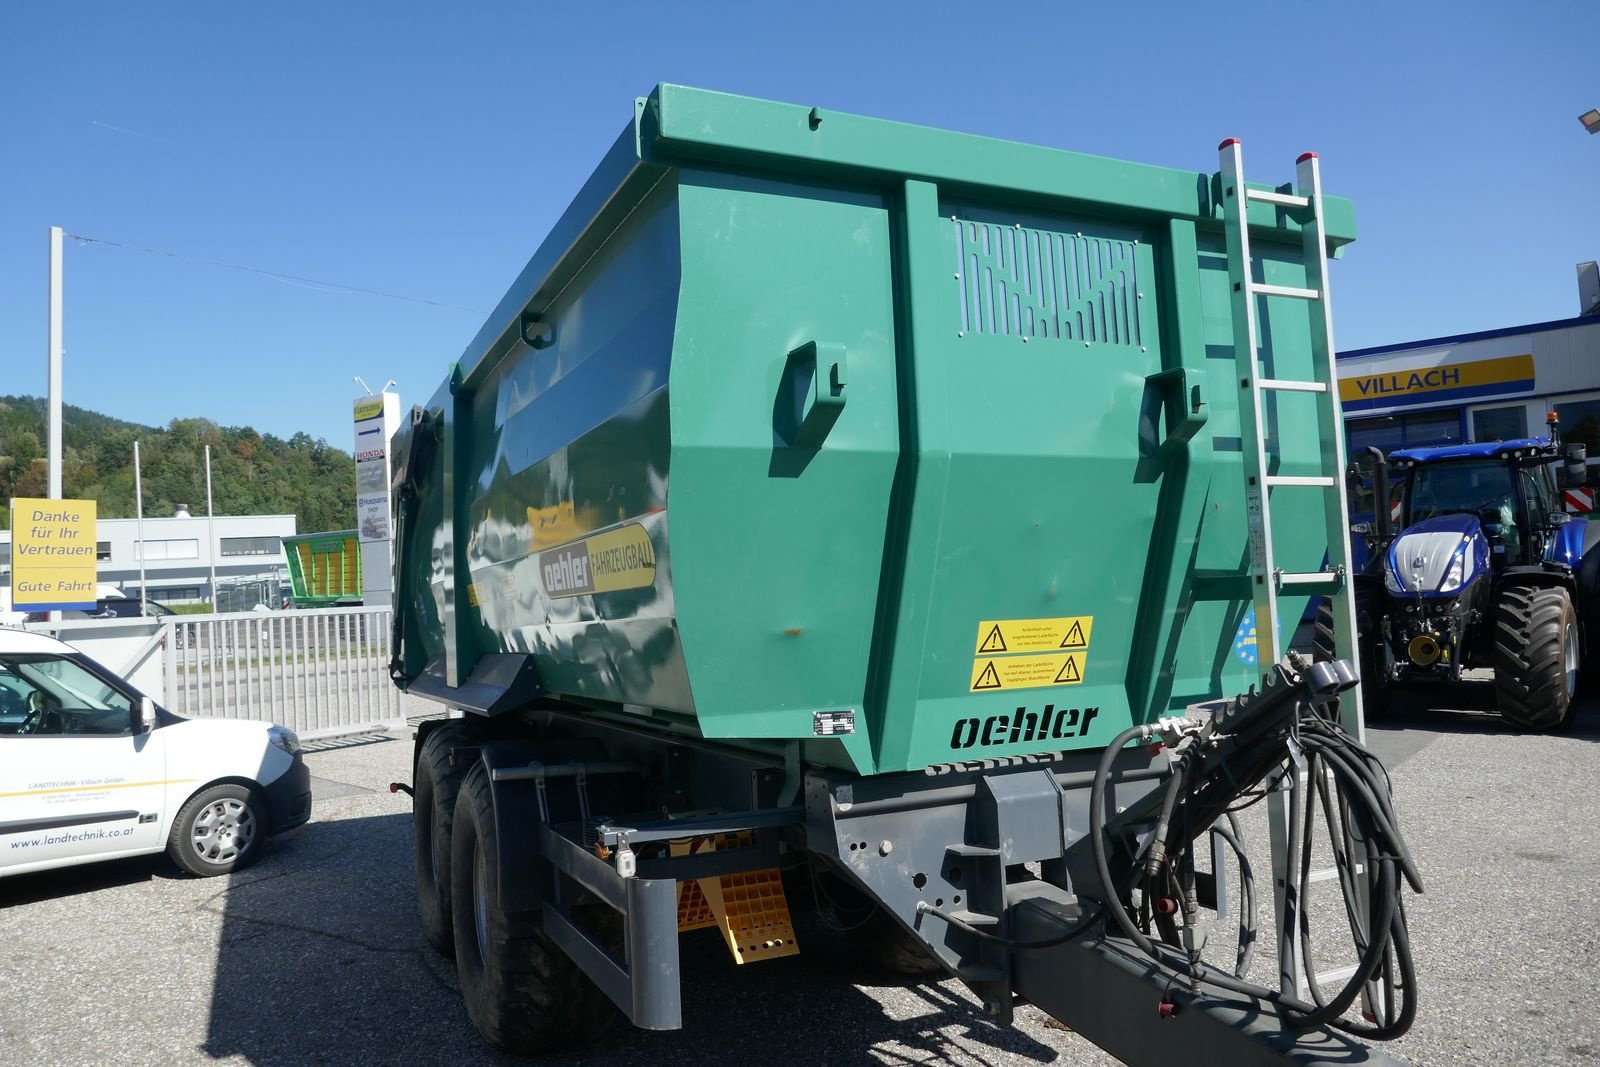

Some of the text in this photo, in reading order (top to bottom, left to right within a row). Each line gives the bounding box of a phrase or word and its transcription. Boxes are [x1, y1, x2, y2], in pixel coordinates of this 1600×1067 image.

[1356, 368, 1460, 395] VILLACH
[357, 449, 385, 459] HONDA
[363, 497, 388, 505] Husqvarna
[32, 510, 80, 522] Danke
[31, 526, 80, 538] für Ihr
[18, 543, 93, 555] Vertrauen
[590, 541, 652, 576] FAHRZEUGBAU
[543, 551, 589, 592] oehler
[17, 580, 93, 592] Gute Fahrt
[950, 704, 1100, 750] oehler
[10, 827, 135, 849] www.landtechnik.co.at
